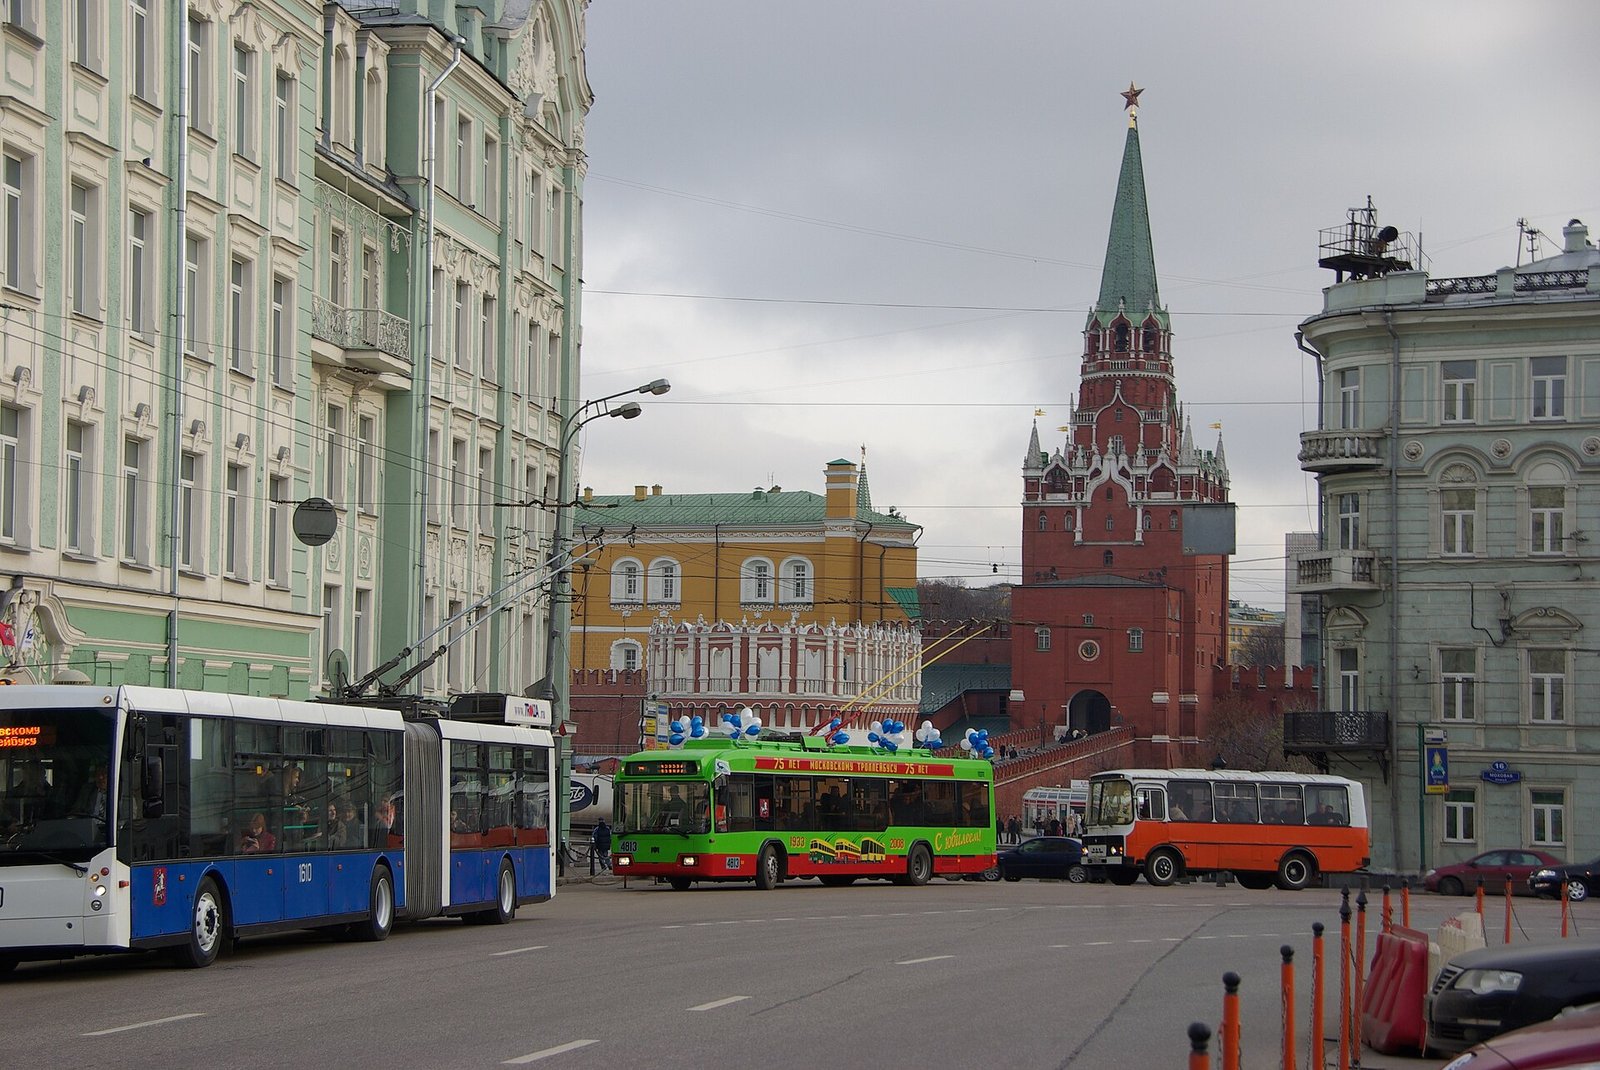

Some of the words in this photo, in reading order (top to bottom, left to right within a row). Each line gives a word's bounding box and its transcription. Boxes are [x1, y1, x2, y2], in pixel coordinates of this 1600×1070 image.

[774, 758, 785, 770] 75
[788, 760, 801, 769] ЛЕТ
[809, 760, 854, 771] МОСКОВСКОМУ
[857, 762, 898, 773] ТРОЛЛЕЙБУСУ
[905, 763, 915, 775] 75
[917, 765, 929, 774] ЛЕТ
[1494, 762, 1505, 770] 16
[620, 841, 638, 853] 4813
[789, 836, 805, 848] 1933
[726, 857, 740, 869] 4813
[298, 862, 312, 883] 1610
